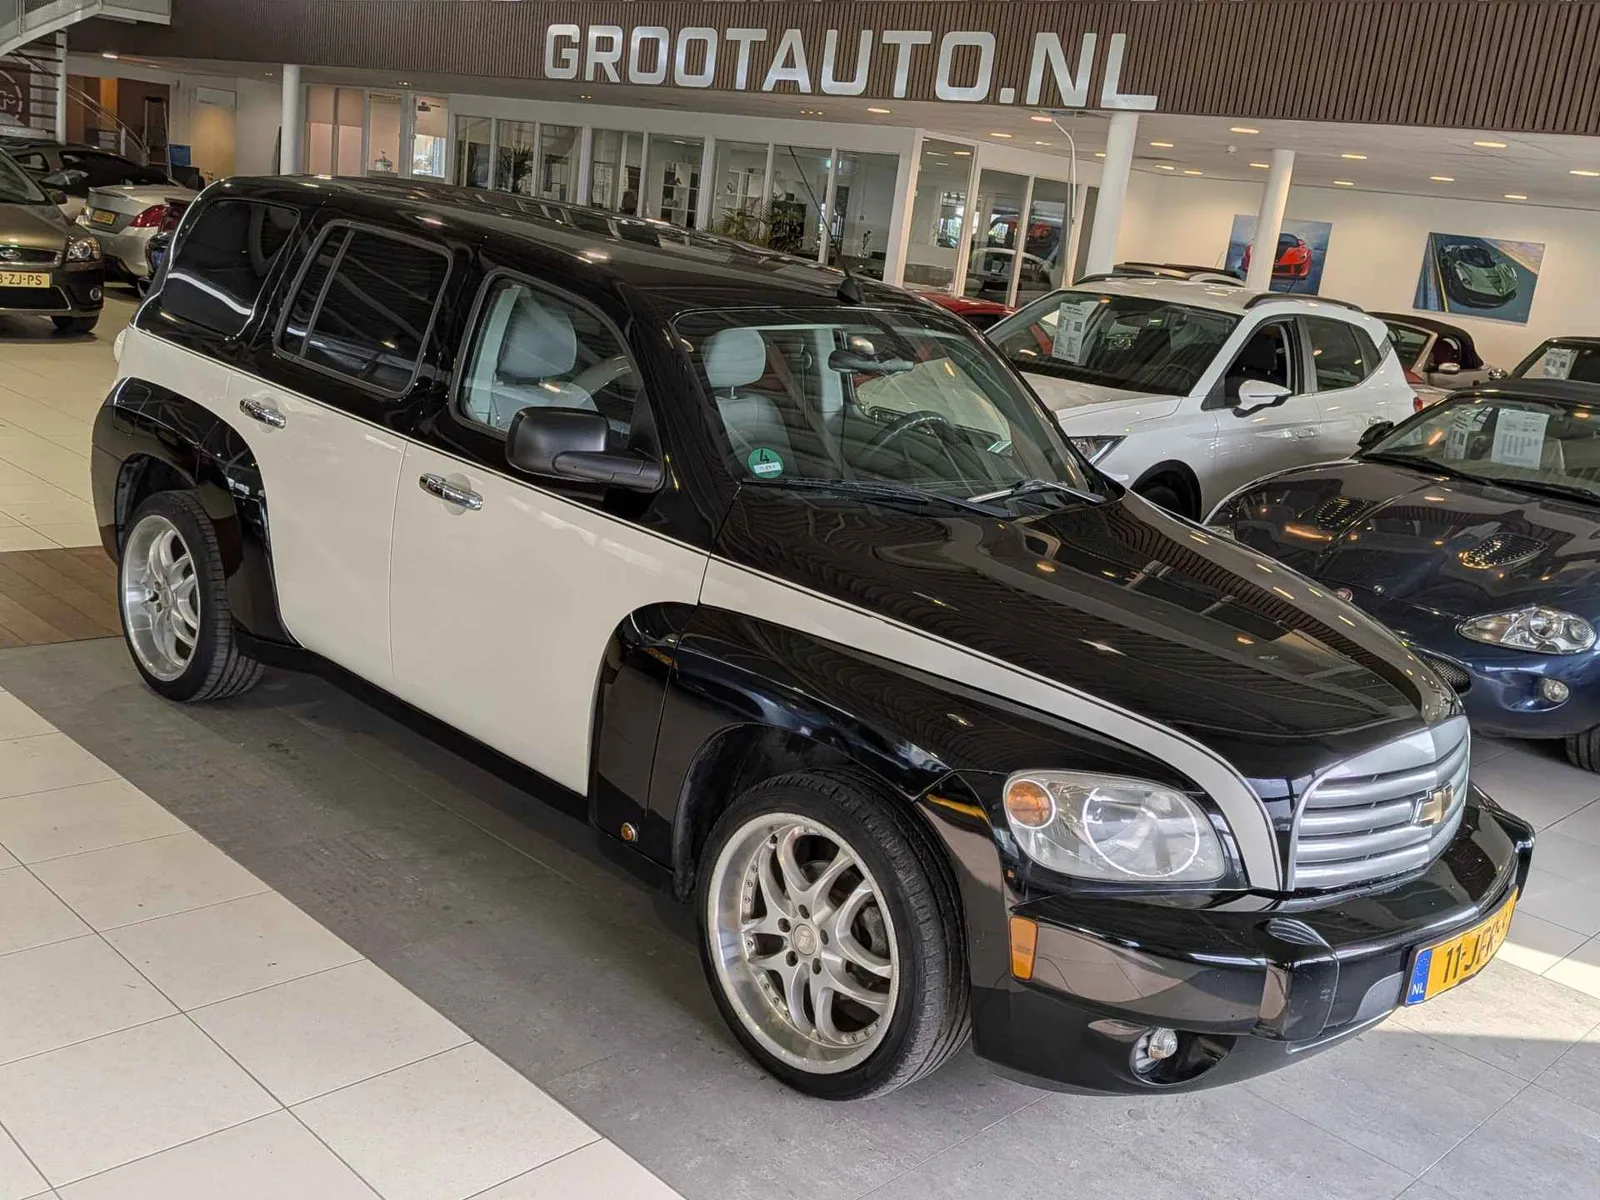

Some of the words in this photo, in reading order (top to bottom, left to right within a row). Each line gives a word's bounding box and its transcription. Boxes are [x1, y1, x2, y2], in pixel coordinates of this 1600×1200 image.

[545, 24, 1157, 110] GROOTAUTO.NL
[760, 449, 770, 464] 4
[1411, 982, 1425, 996] NL
